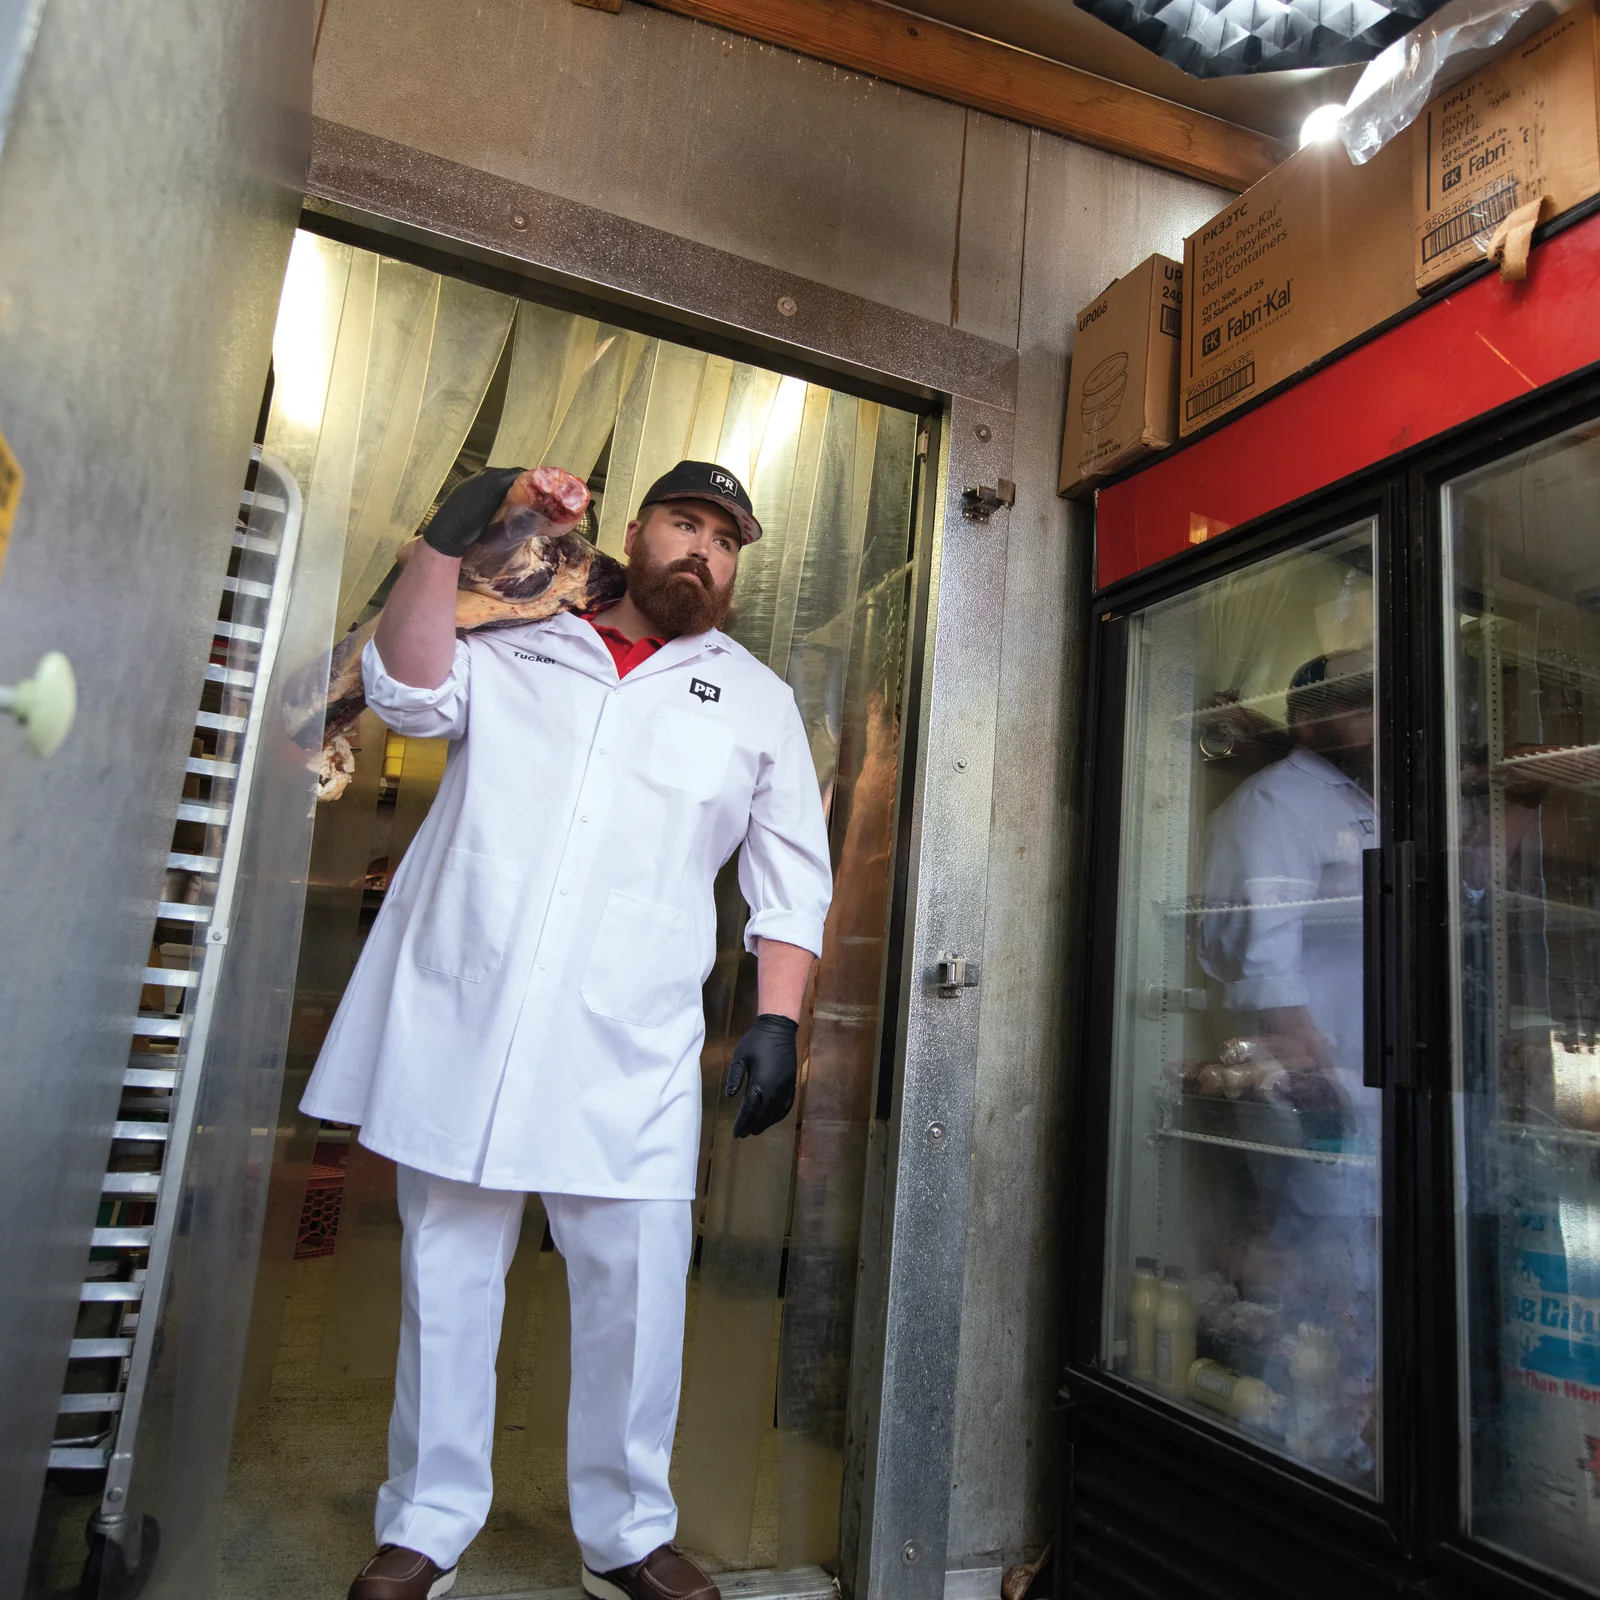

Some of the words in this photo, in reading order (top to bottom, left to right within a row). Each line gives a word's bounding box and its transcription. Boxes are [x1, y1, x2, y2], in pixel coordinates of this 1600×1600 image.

[1442, 132, 1462, 151] Flat
[1442, 160, 1452, 170] 10
[1454, 140, 1484, 163] Sleeves
[1486, 132, 1496, 142] of
[1462, 135, 1478, 149] 500
[1203, 202, 1248, 246] PK32TC
[1426, 199, 1472, 232] 9505466
[1202, 217, 1282, 282] Polypropylene
[1202, 250, 1216, 268] 32
[1218, 241, 1234, 256] oz.
[1202, 272, 1222, 297] Deli
[1226, 230, 1288, 279] Containers
[1202, 299, 1220, 316] QTY:
[1222, 288, 1236, 304] 500
[1202, 314, 1212, 326] 20
[1213, 295, 1242, 319] Sleeves
[1244, 284, 1252, 298] of
[1254, 278, 1264, 292] 25
[1187, 373, 1218, 398] 9505104
[1222, 355, 1252, 377] PK32TC
[715, 474, 734, 491] PR
[513, 650, 556, 664] Tucker
[694, 682, 716, 699] PR
